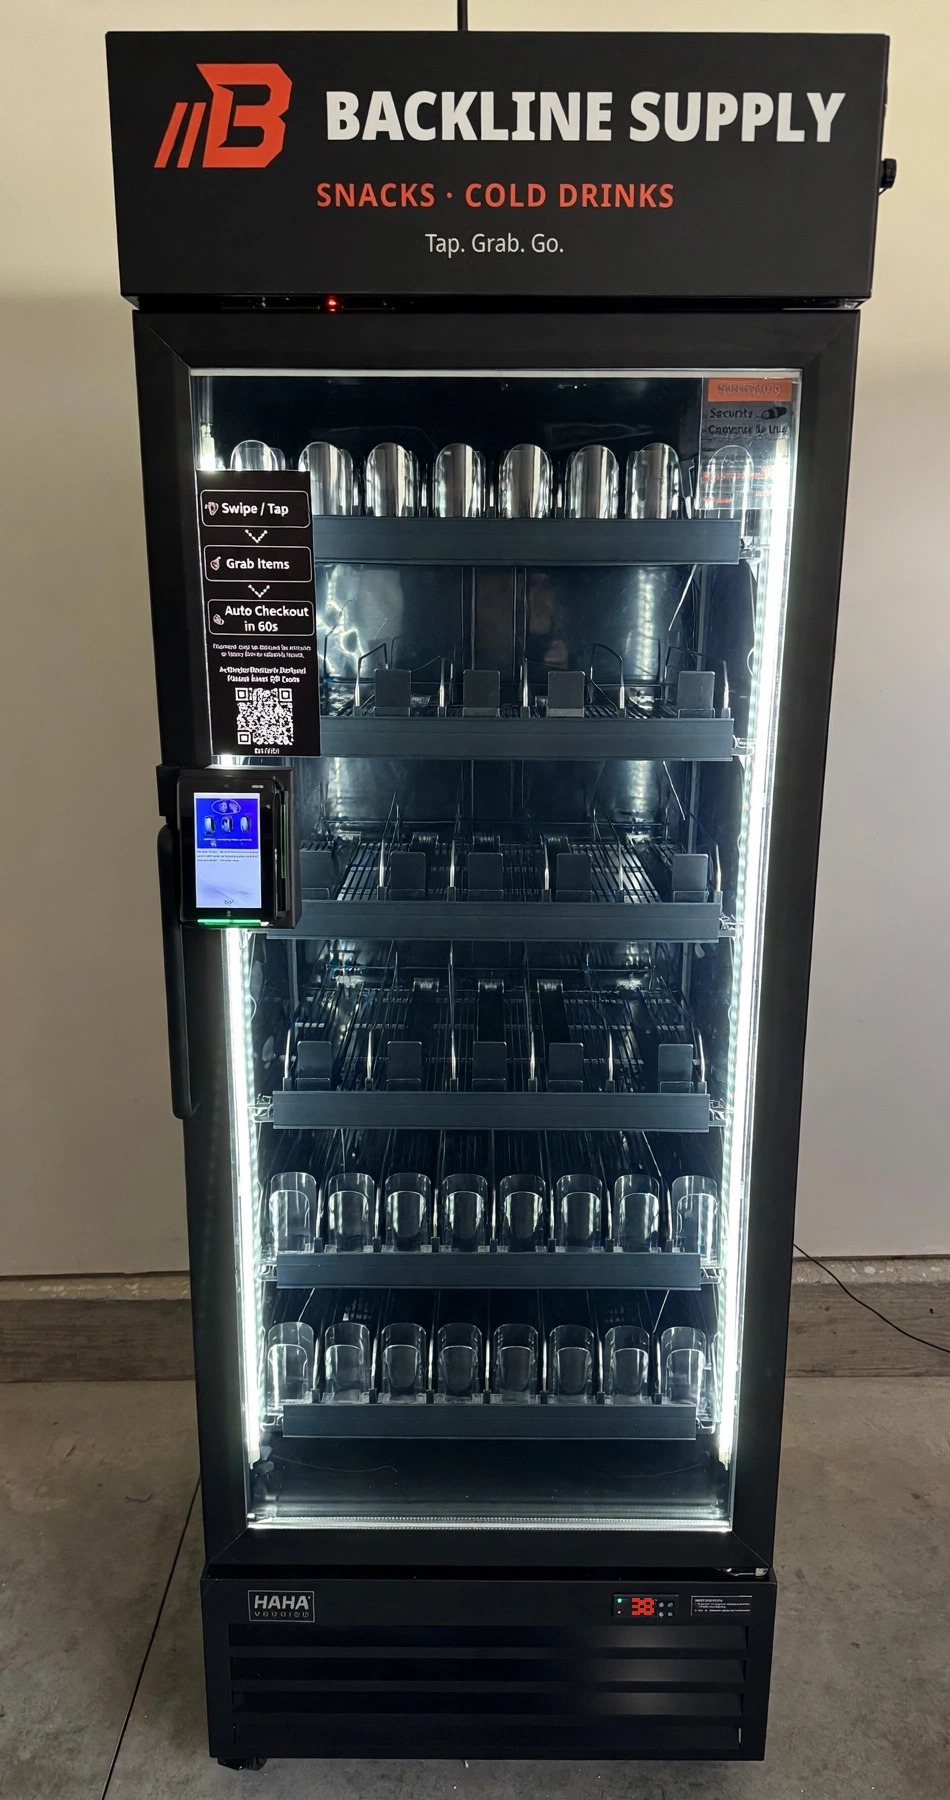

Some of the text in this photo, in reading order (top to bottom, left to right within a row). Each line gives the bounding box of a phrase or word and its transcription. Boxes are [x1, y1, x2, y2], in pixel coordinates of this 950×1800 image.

[326, 91, 846, 143] BACKLINE SUPPLY
[317, 183, 435, 208] SNACKS
[465, 183, 546, 208] COLD
[559, 183, 674, 208] DRINKS
[425, 232, 564, 258] Tap. Grab. Go.
[221, 502, 258, 516] Swipe
[267, 502, 289, 517] Tap
[226, 557, 290, 570] Grab Items
[224, 605, 310, 617] Auto Checkout
[244, 621, 279, 632] in 60s
[254, 1595, 310, 1610] HAHA
